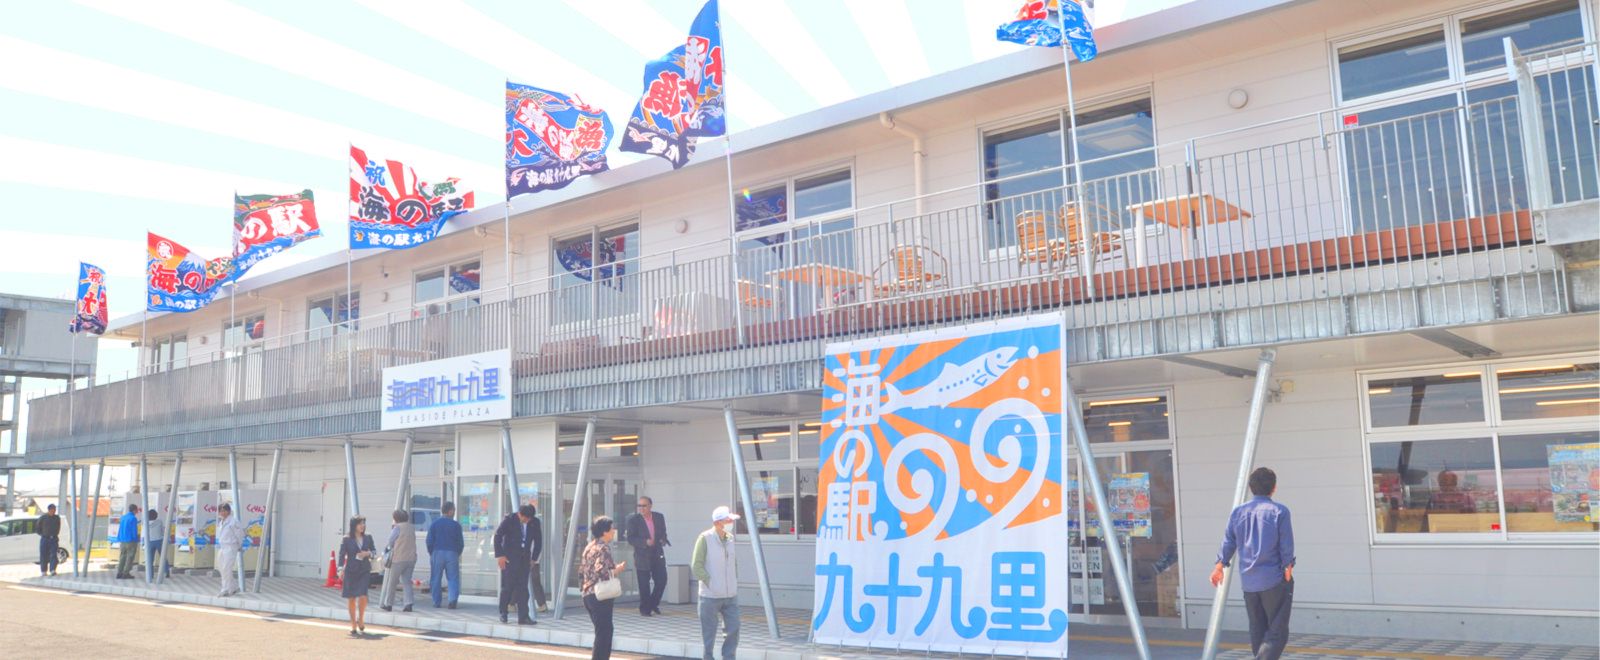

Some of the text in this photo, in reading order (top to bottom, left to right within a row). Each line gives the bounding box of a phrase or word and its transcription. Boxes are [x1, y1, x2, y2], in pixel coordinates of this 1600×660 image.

[365, 160, 386, 187] 祝
[400, 407, 491, 425] SEASIDE PLAZA
[819, 358, 888, 542] 海の駅
[814, 551, 1068, 643] 九十九里
